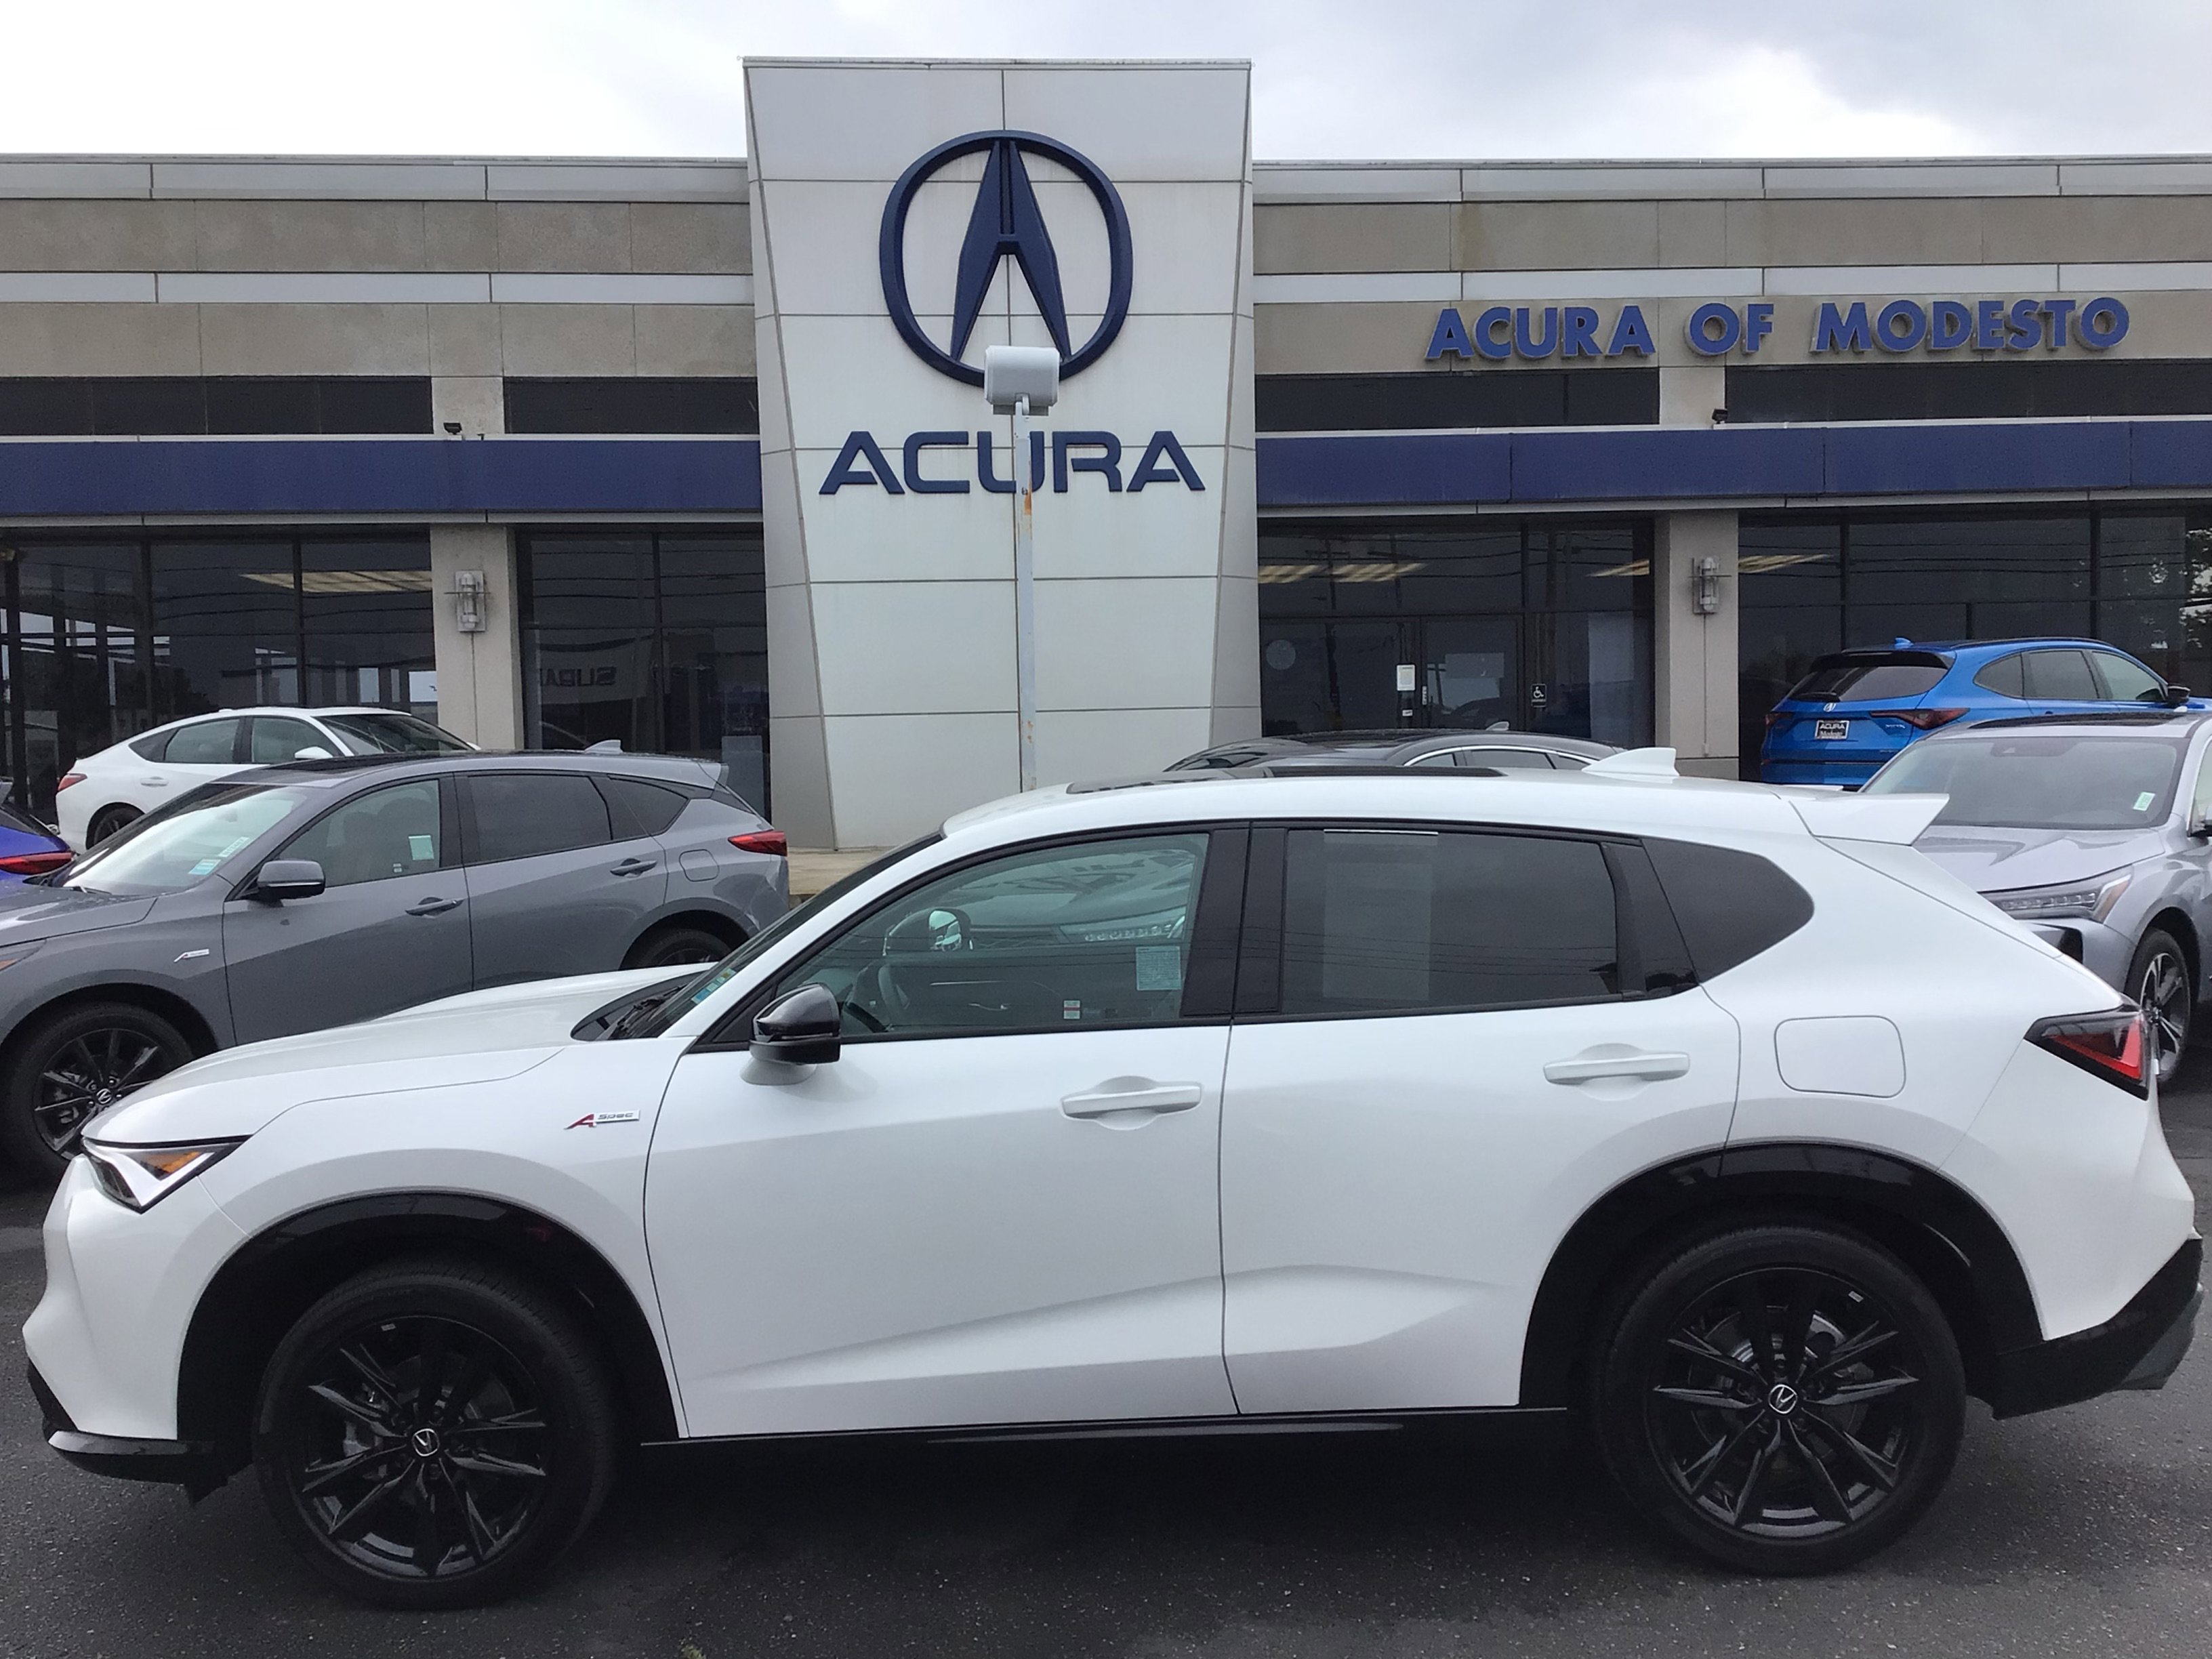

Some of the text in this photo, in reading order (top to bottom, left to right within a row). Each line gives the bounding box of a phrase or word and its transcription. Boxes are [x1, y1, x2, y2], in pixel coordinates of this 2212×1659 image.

[1425, 297, 2130, 359] ACURA OF MODESTO
[819, 430, 1206, 495] ACURA
